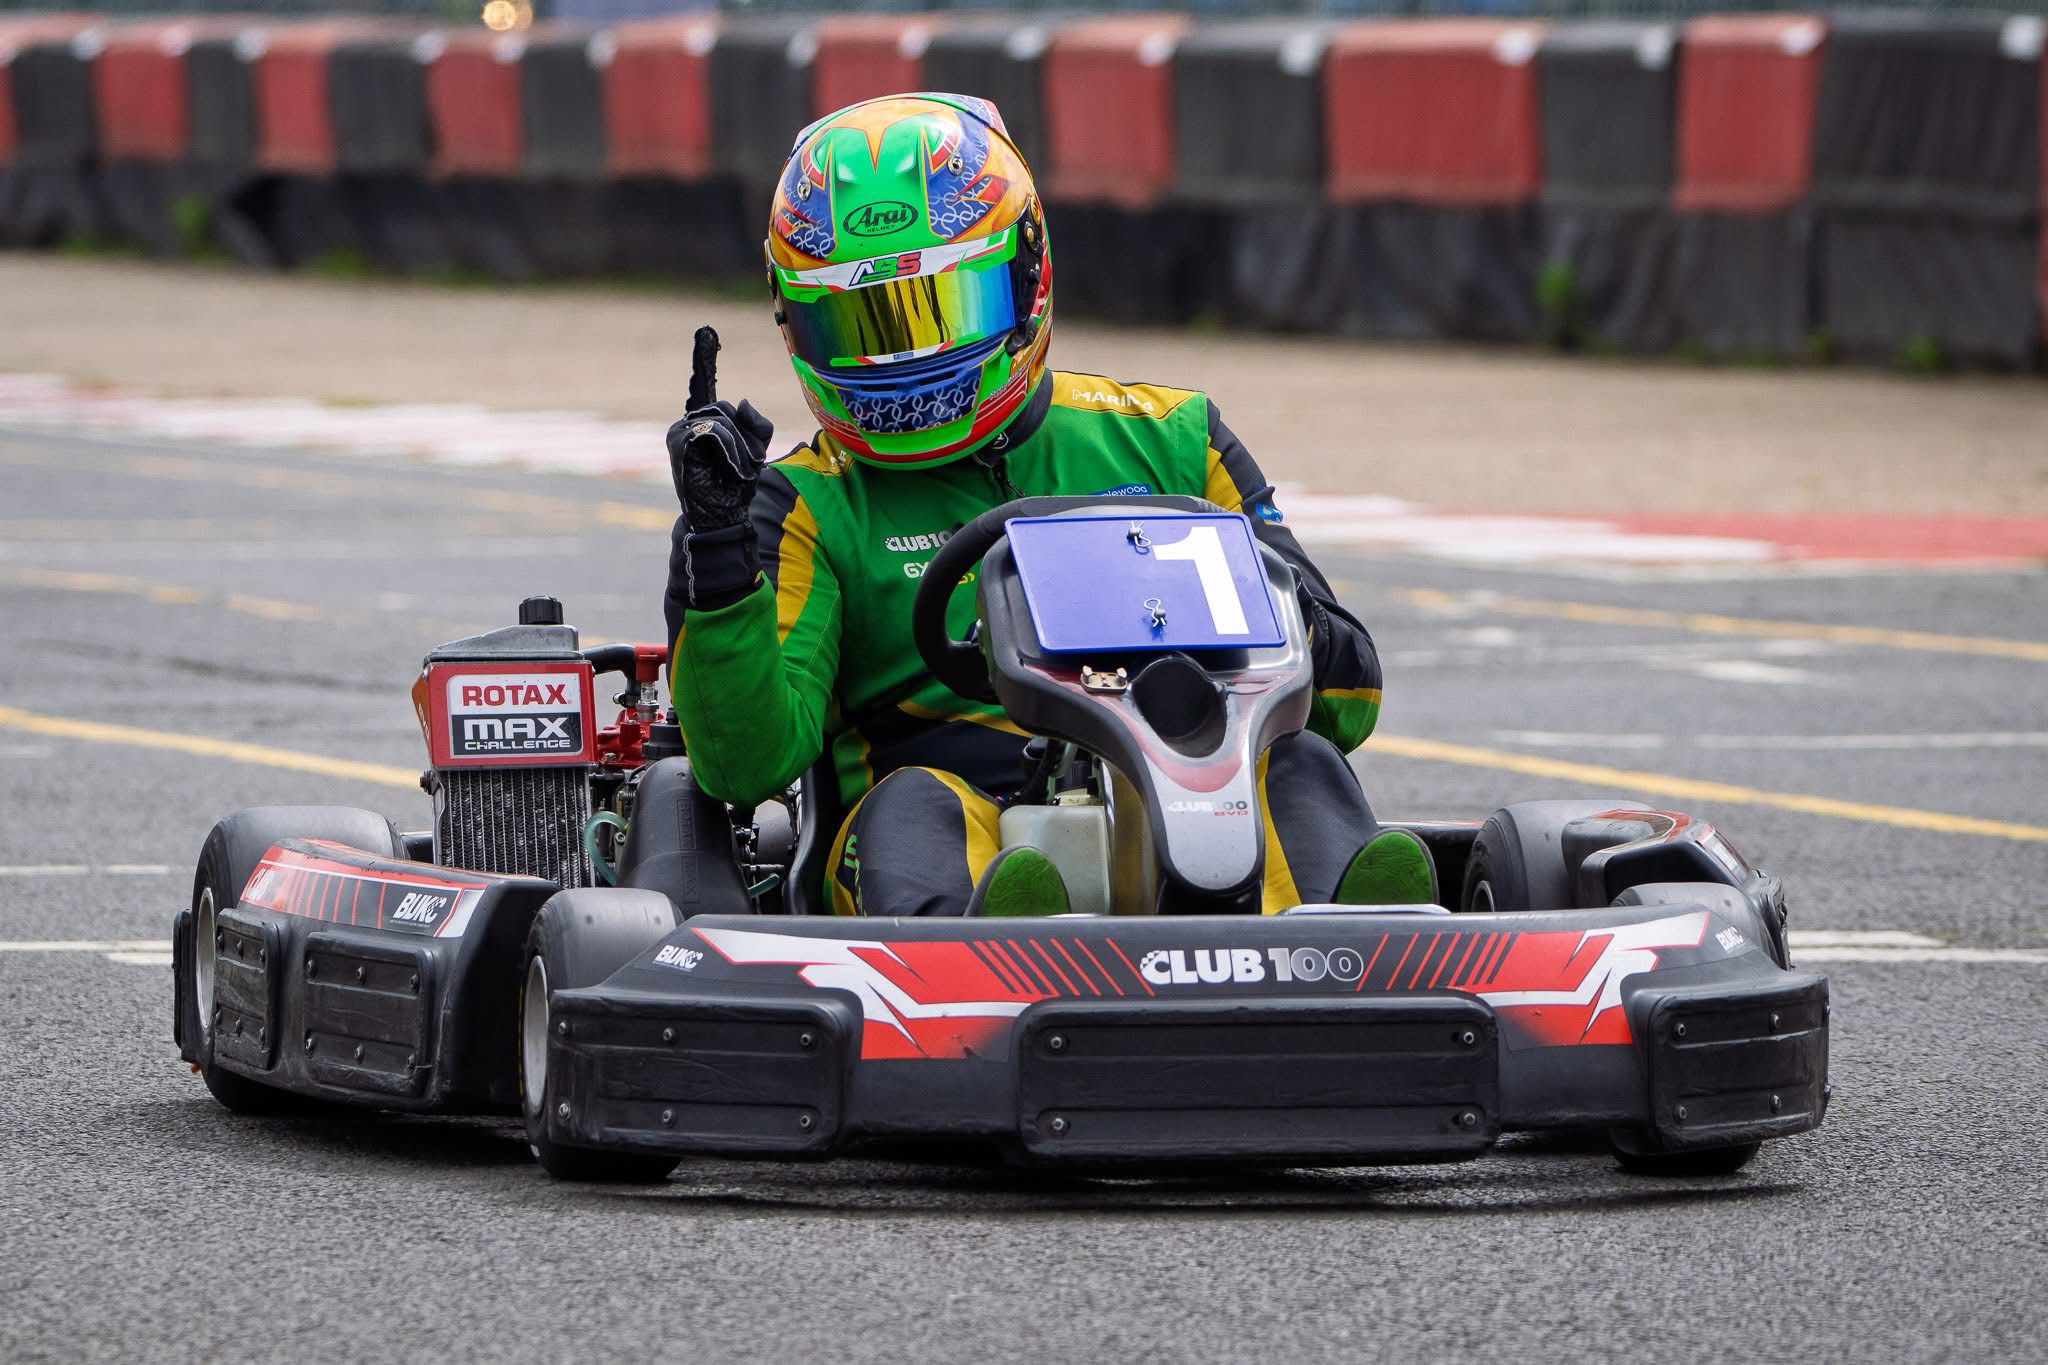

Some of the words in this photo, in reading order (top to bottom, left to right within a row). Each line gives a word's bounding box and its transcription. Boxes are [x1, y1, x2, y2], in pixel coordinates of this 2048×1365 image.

[849, 203, 909, 233] Arai
[848, 251, 922, 287] ABS
[1152, 526, 1250, 635] 1
[462, 684, 567, 706] ROTAX
[463, 717, 569, 740] MAX
[465, 739, 571, 750] CHALLENGE
[392, 892, 447, 924] BUKC
[654, 944, 703, 969] BUKC
